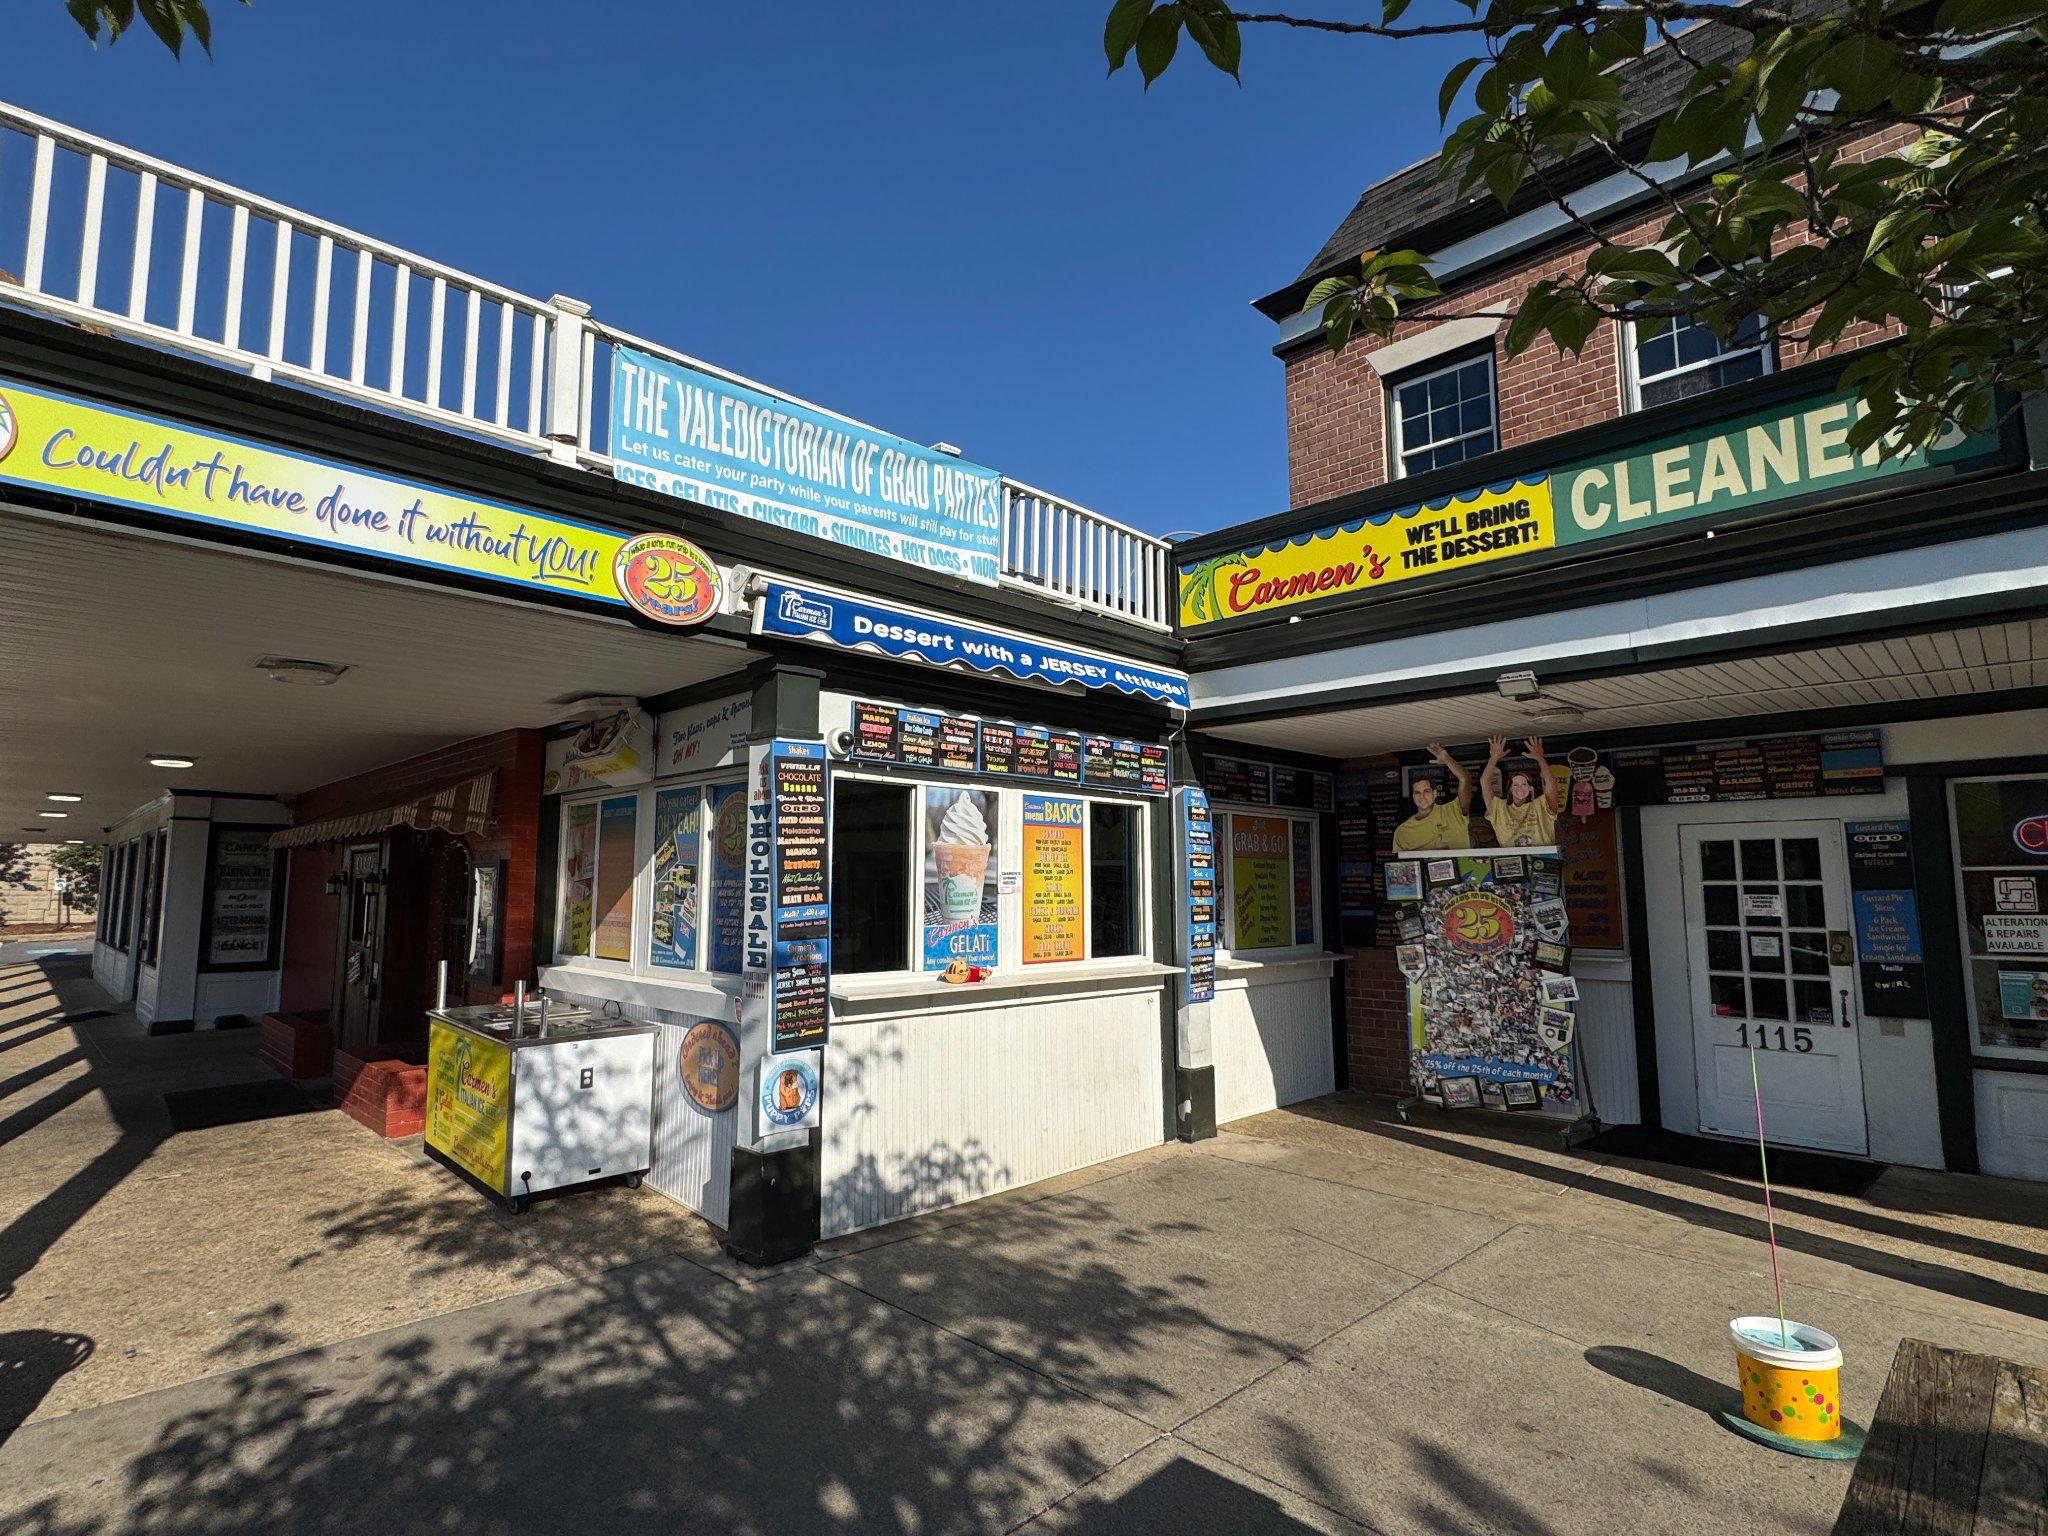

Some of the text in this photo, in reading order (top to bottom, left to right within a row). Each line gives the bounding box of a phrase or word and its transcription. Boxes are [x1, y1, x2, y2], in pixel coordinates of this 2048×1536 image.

[621, 361, 1001, 530] THE VALEDICTORIAN OF GRAD PARTIES
[621, 434, 1000, 548] Let us cater your party while your parents will still pay for stuff
[41, 428, 230, 500] Couldn't
[227, 464, 308, 514] have
[316, 484, 391, 534] done
[399, 498, 428, 544] it
[426, 511, 531, 567] without
[1406, 499, 1531, 546] WE'LL BRING
[752, 500, 819, 537] CUSTARD
[831, 521, 892, 556] SUNDAES
[901, 538, 927, 564] HOT
[927, 546, 961, 573] DOGS
[970, 553, 1000, 579] MORE
[1400, 521, 1541, 570] THE DESSERT!
[643, 556, 698, 603] 25
[1228, 544, 1391, 613] Carmen's
[853, 615, 1188, 697] Dessert with a JERSEY Attitude!
[862, 714, 890, 725] MANGO
[859, 723, 893, 734] CHERRY
[862, 739, 888, 749] LEMON
[903, 735, 934, 747] Sour Apple
[787, 745, 811, 756] Shakes
[780, 762, 821, 772] VANILLA
[778, 772, 822, 782] CHOCOLATE
[1718, 776, 1763, 786] CARAMEL
[784, 782, 818, 793] Banana
[1775, 781, 1814, 789] PEANUTS
[781, 804, 821, 813] OREO
[1024, 800, 1083, 825] menu BASICS
[657, 808, 700, 837] OH YEAH!
[1855, 823, 1883, 832] Custard
[777, 837, 826, 846] Marshmallow
[1234, 832, 1287, 853] GRAB & GO!
[1853, 833, 1903, 842] OREO
[225, 843, 270, 853] CAMPS
[786, 847, 818, 856] MANGO
[747, 804, 772, 968] WHOLESALE
[782, 892, 824, 904] HEATH BAR
[1862, 894, 1890, 902] Custard
[1456, 907, 1501, 939] 25
[1880, 916, 1898, 924] Pack
[928, 915, 979, 947] Carmen's
[1879, 925, 1905, 933] Cream
[1986, 929, 2039, 938] & REPAIRS
[1866, 932, 1911, 942] Sandwiches
[220, 941, 260, 951] DANCE
[787, 942, 817, 953] Carmen's
[1872, 943, 1907, 953] Single Ice
[1988, 940, 2044, 951] AVAILABLE
[1861, 952, 1922, 961] Cream Sandwich
[1736, 1022, 1814, 1053] 1115
[1425, 1060, 1553, 1080] 25% off the 25th of each month!
[461, 1062, 498, 1100] Carmen's
[763, 1094, 789, 1124] PUPPY
